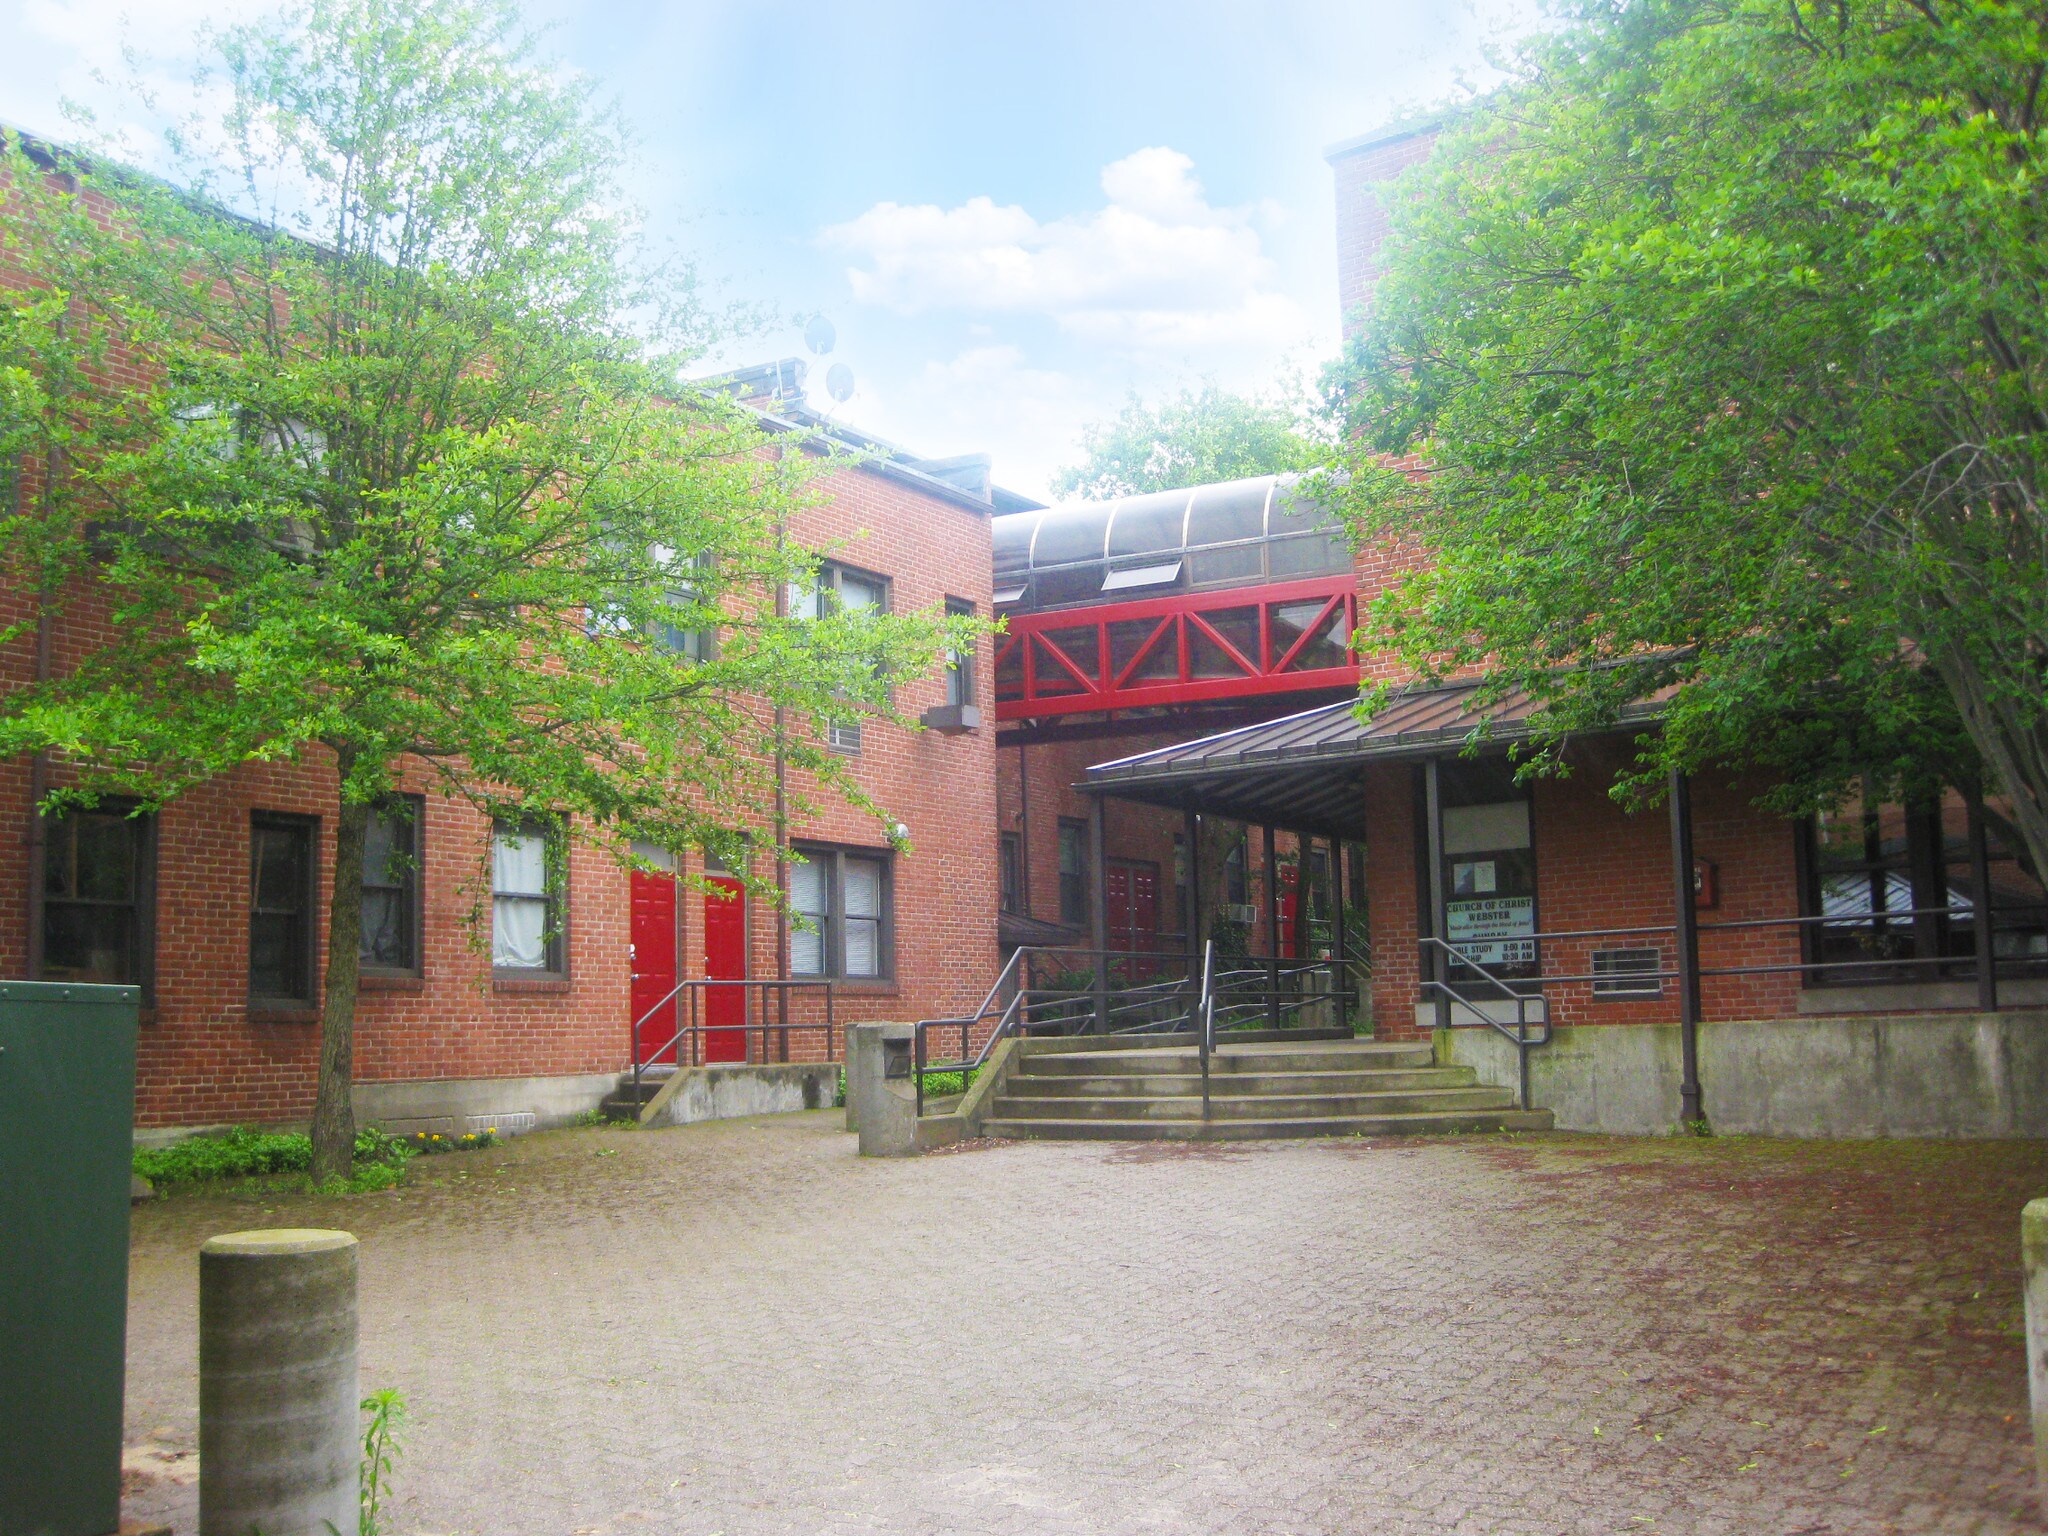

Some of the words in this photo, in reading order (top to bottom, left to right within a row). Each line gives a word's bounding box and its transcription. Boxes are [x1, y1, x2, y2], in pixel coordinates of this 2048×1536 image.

[1447, 902, 1482, 912] CHURCH
[1485, 901, 1496, 909] OF
[1499, 899, 1531, 909] CHRIST
[1468, 911, 1510, 921] WEBSTER
[1471, 944, 1492, 953] STUDY
[1521, 942, 1532, 950] AM
[1522, 951, 1532, 960] AM
